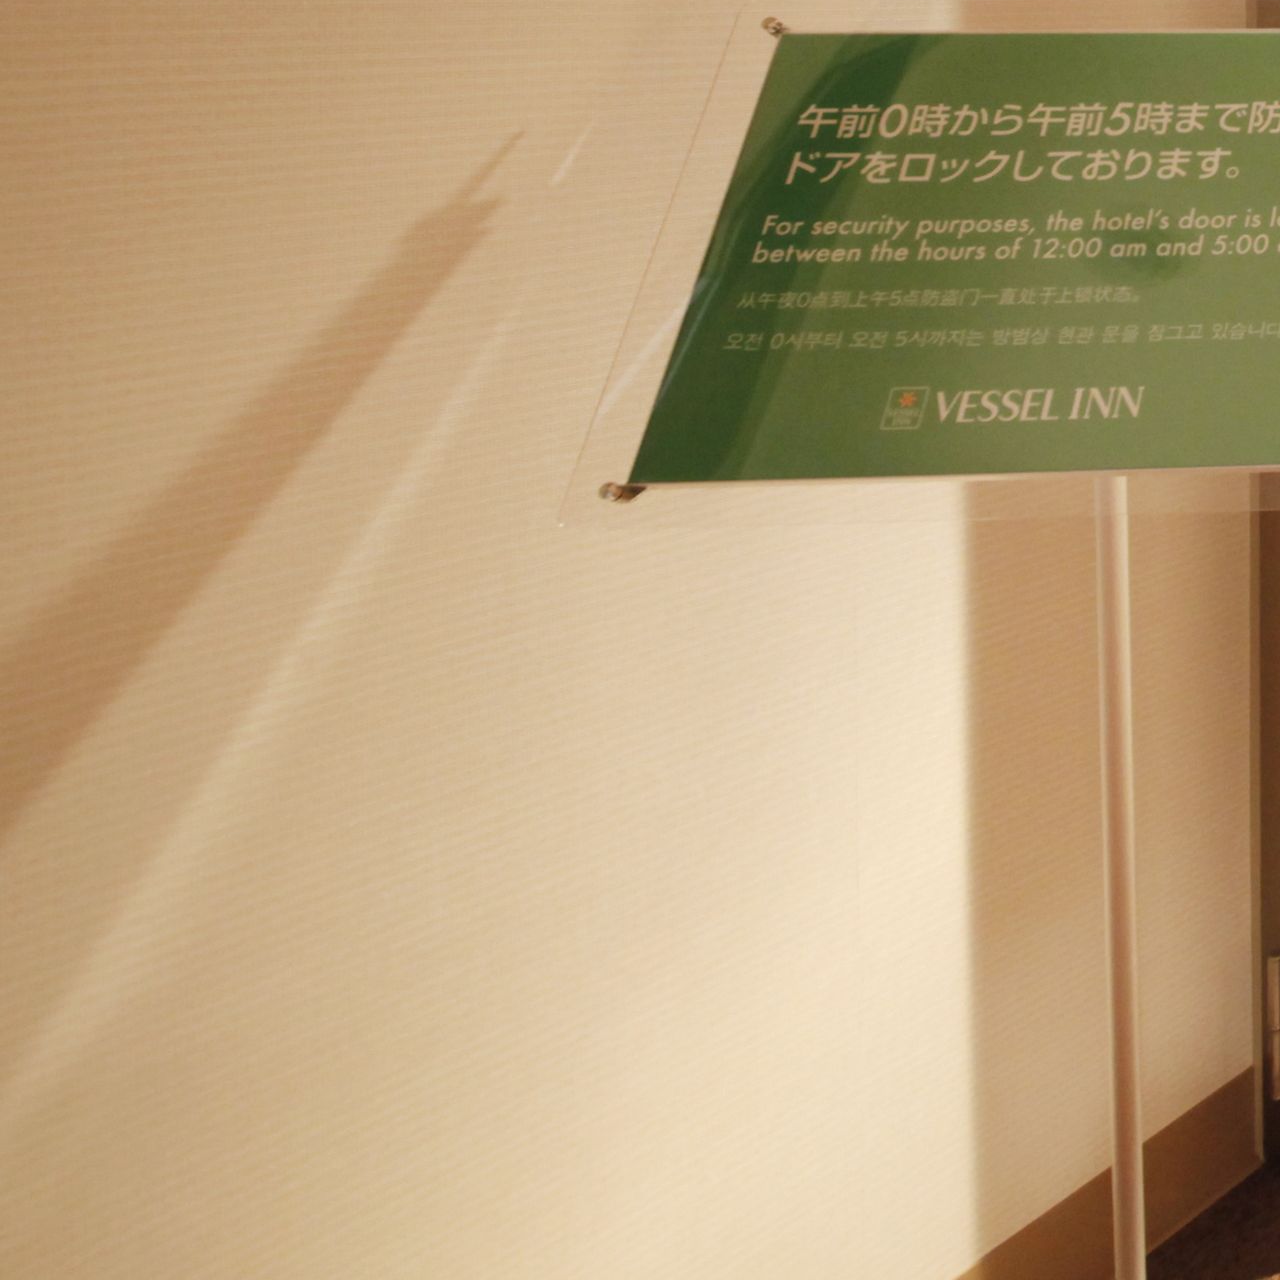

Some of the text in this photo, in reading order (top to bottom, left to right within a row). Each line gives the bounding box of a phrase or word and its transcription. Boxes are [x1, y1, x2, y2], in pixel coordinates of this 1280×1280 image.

[784, 146, 1240, 185] ドアをロックしております。
[761, 214, 804, 236] For
[811, 214, 909, 240] security
[915, 217, 1036, 239] purposes,
[1045, 210, 1083, 232] the
[1091, 208, 1170, 231] hotel's
[1178, 207, 1237, 229] door
[1244, 208, 1262, 228] is
[752, 241, 862, 264] between
[870, 239, 909, 262] the
[917, 239, 986, 261] hours
[994, 237, 1023, 261] of
[1031, 237, 1102, 259] 12:00
[1109, 241, 1147, 258] am
[1155, 234, 1205, 257] and
[1211, 233, 1270, 256] 5:00
[723, 331, 765, 351] 오전
[848, 329, 889, 350] 오전
[936, 388, 1059, 424] VESSEL
[1067, 385, 1145, 420] INN
